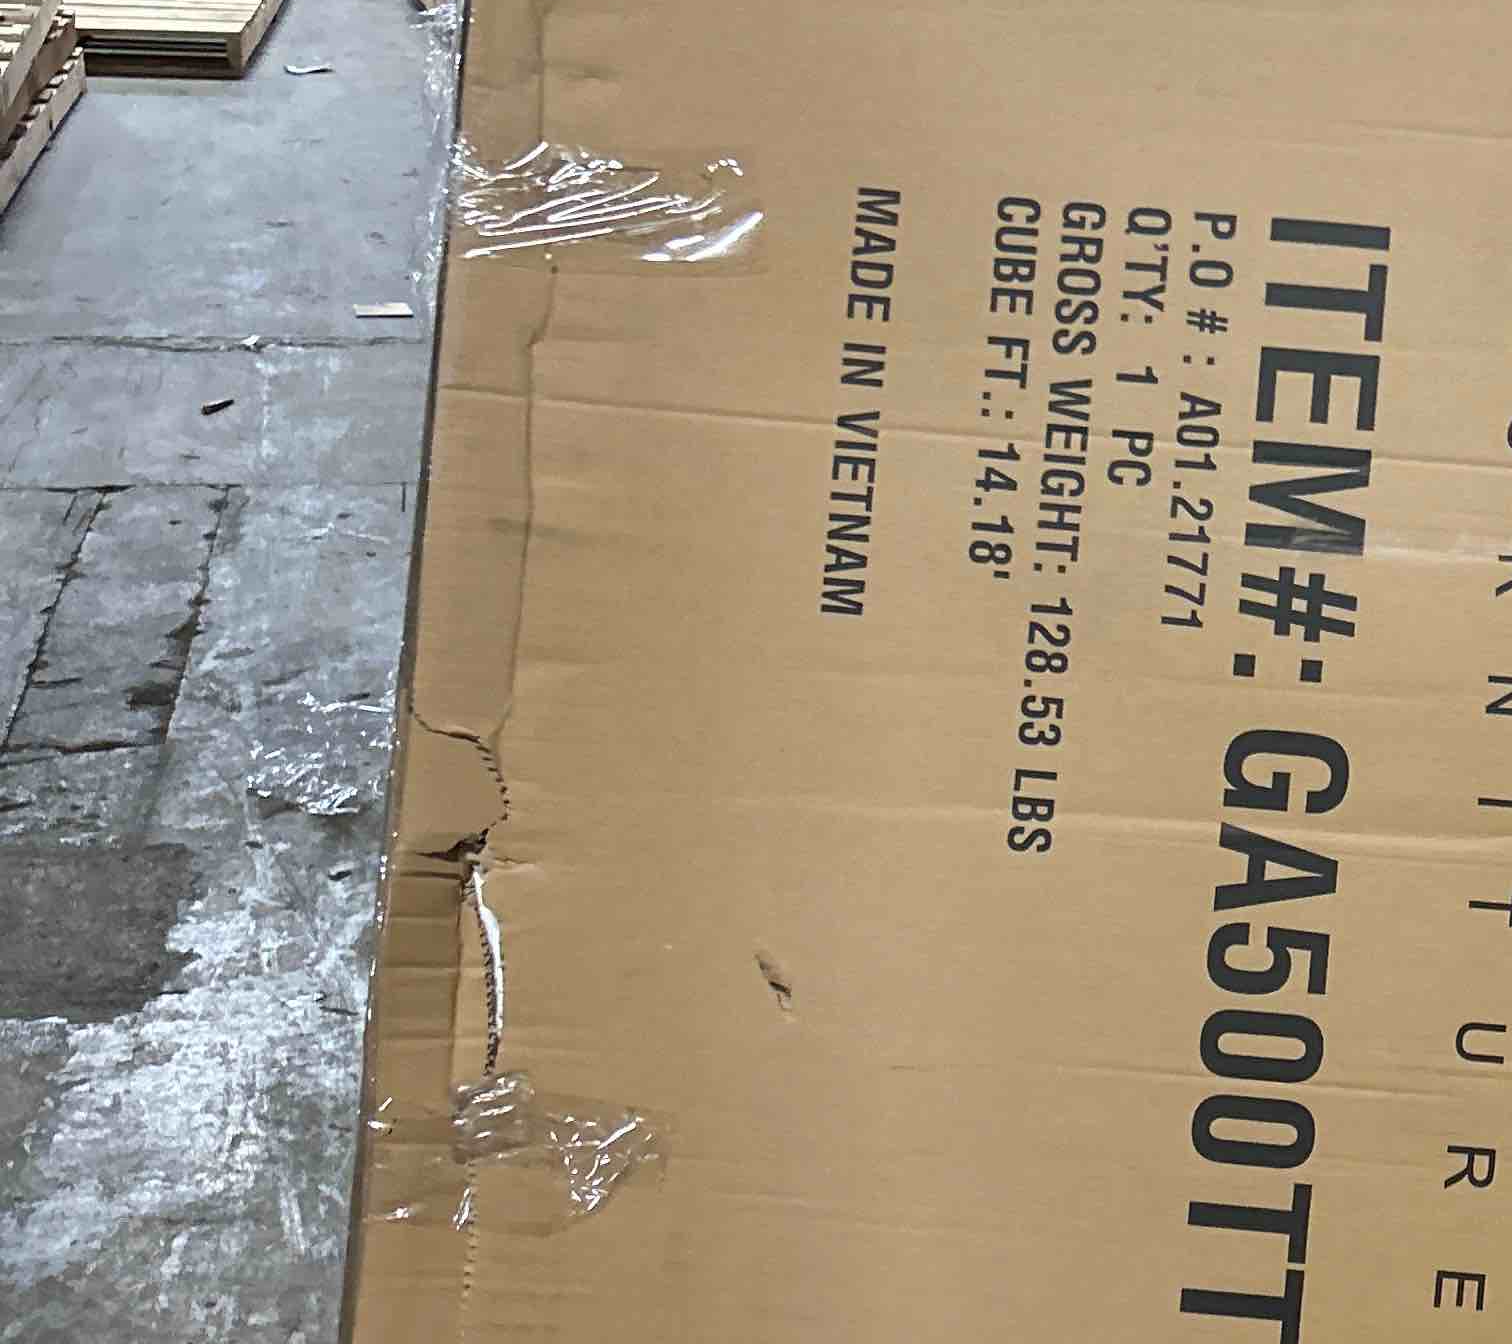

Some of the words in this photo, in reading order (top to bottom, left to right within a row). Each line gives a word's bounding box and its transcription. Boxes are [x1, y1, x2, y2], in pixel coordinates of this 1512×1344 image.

[846, 186, 902, 324] MADE
[988, 195, 1042, 317] CUBE
[1051, 201, 1108, 356] GROSS
[1119, 206, 1173, 324] Q'TY:
[1187, 211, 1239, 289] P.O
[839, 341, 888, 389] IN
[981, 334, 1032, 418] FT.:
[1114, 364, 1160, 386] 1
[819, 409, 882, 617] VIETNAM
[967, 441, 1022, 581] 14.18'
[1032, 377, 1094, 573] WEIGHT:
[1106, 428, 1156, 488] PC
[1160, 390, 1223, 631] A01.21771
[1231, 216, 1391, 684] ITEM#:
[1017, 596, 1074, 748] 128.53
[1005, 767, 1059, 854] LBS
